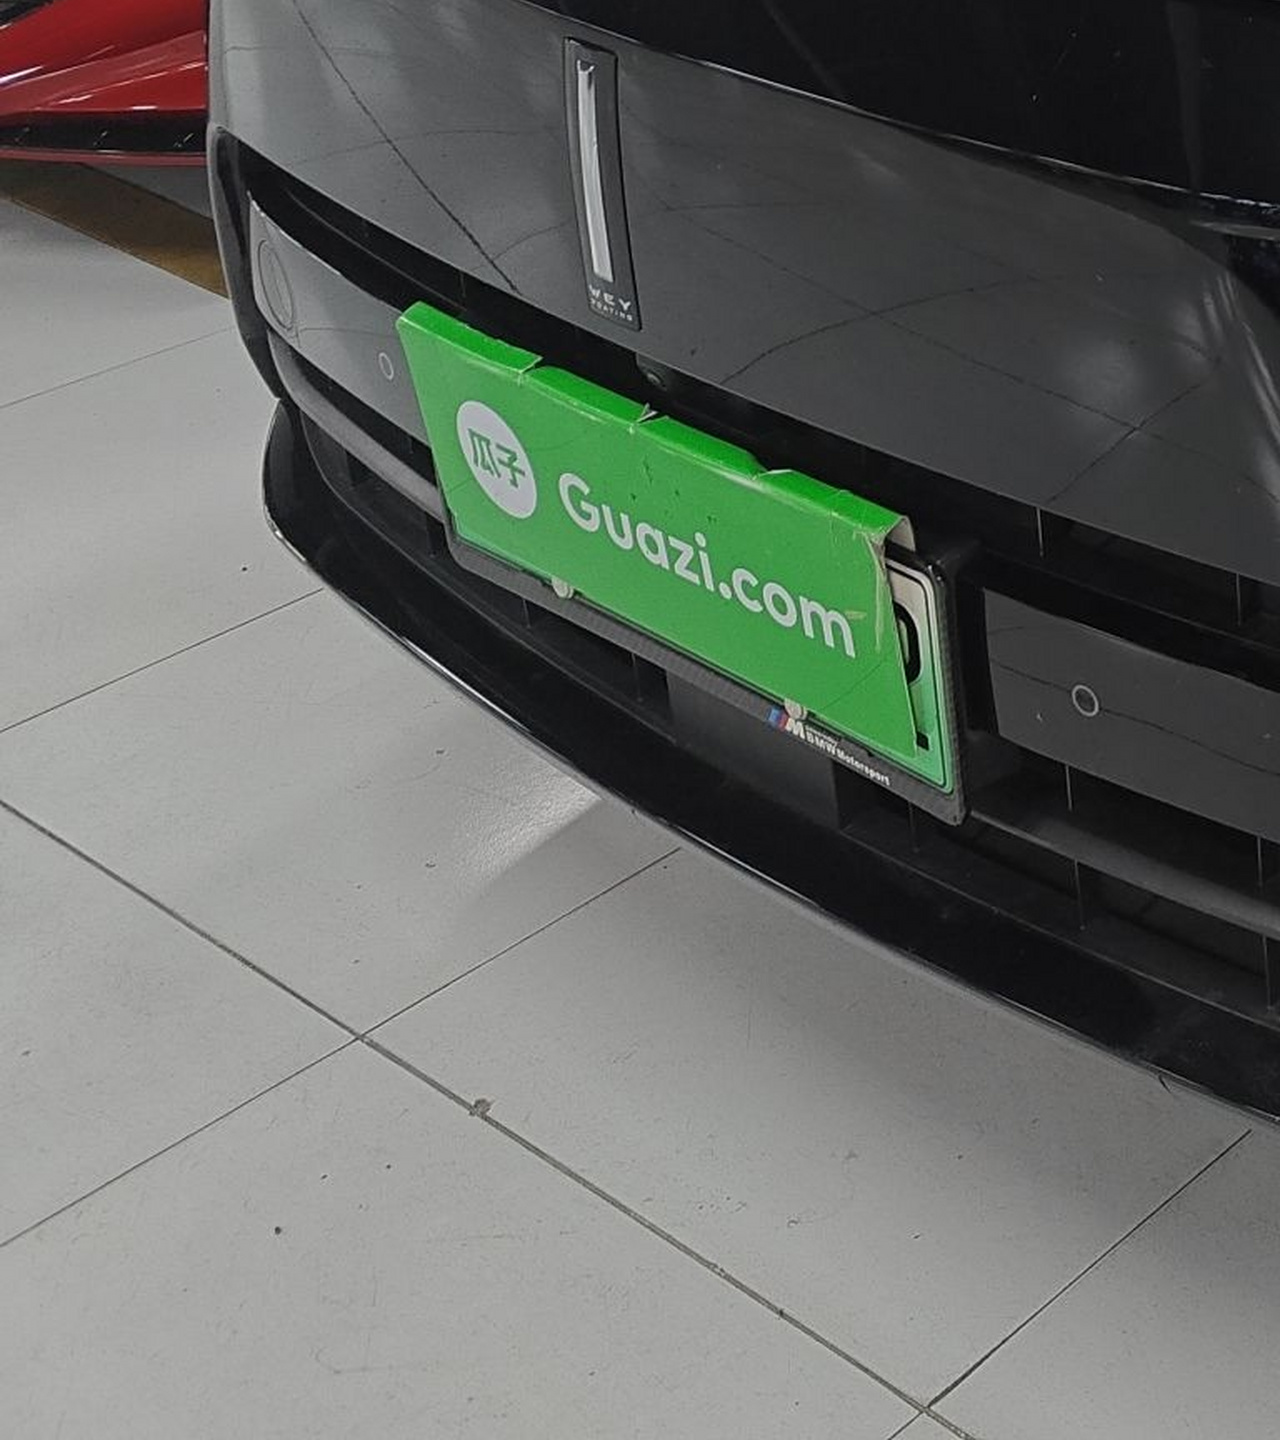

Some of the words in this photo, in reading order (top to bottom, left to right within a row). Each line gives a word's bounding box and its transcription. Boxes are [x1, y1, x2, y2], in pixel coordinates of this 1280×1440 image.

[588, 284, 631, 311] WEY
[467, 427, 525, 488] 瓜子
[558, 472, 856, 659] Guazi.com
